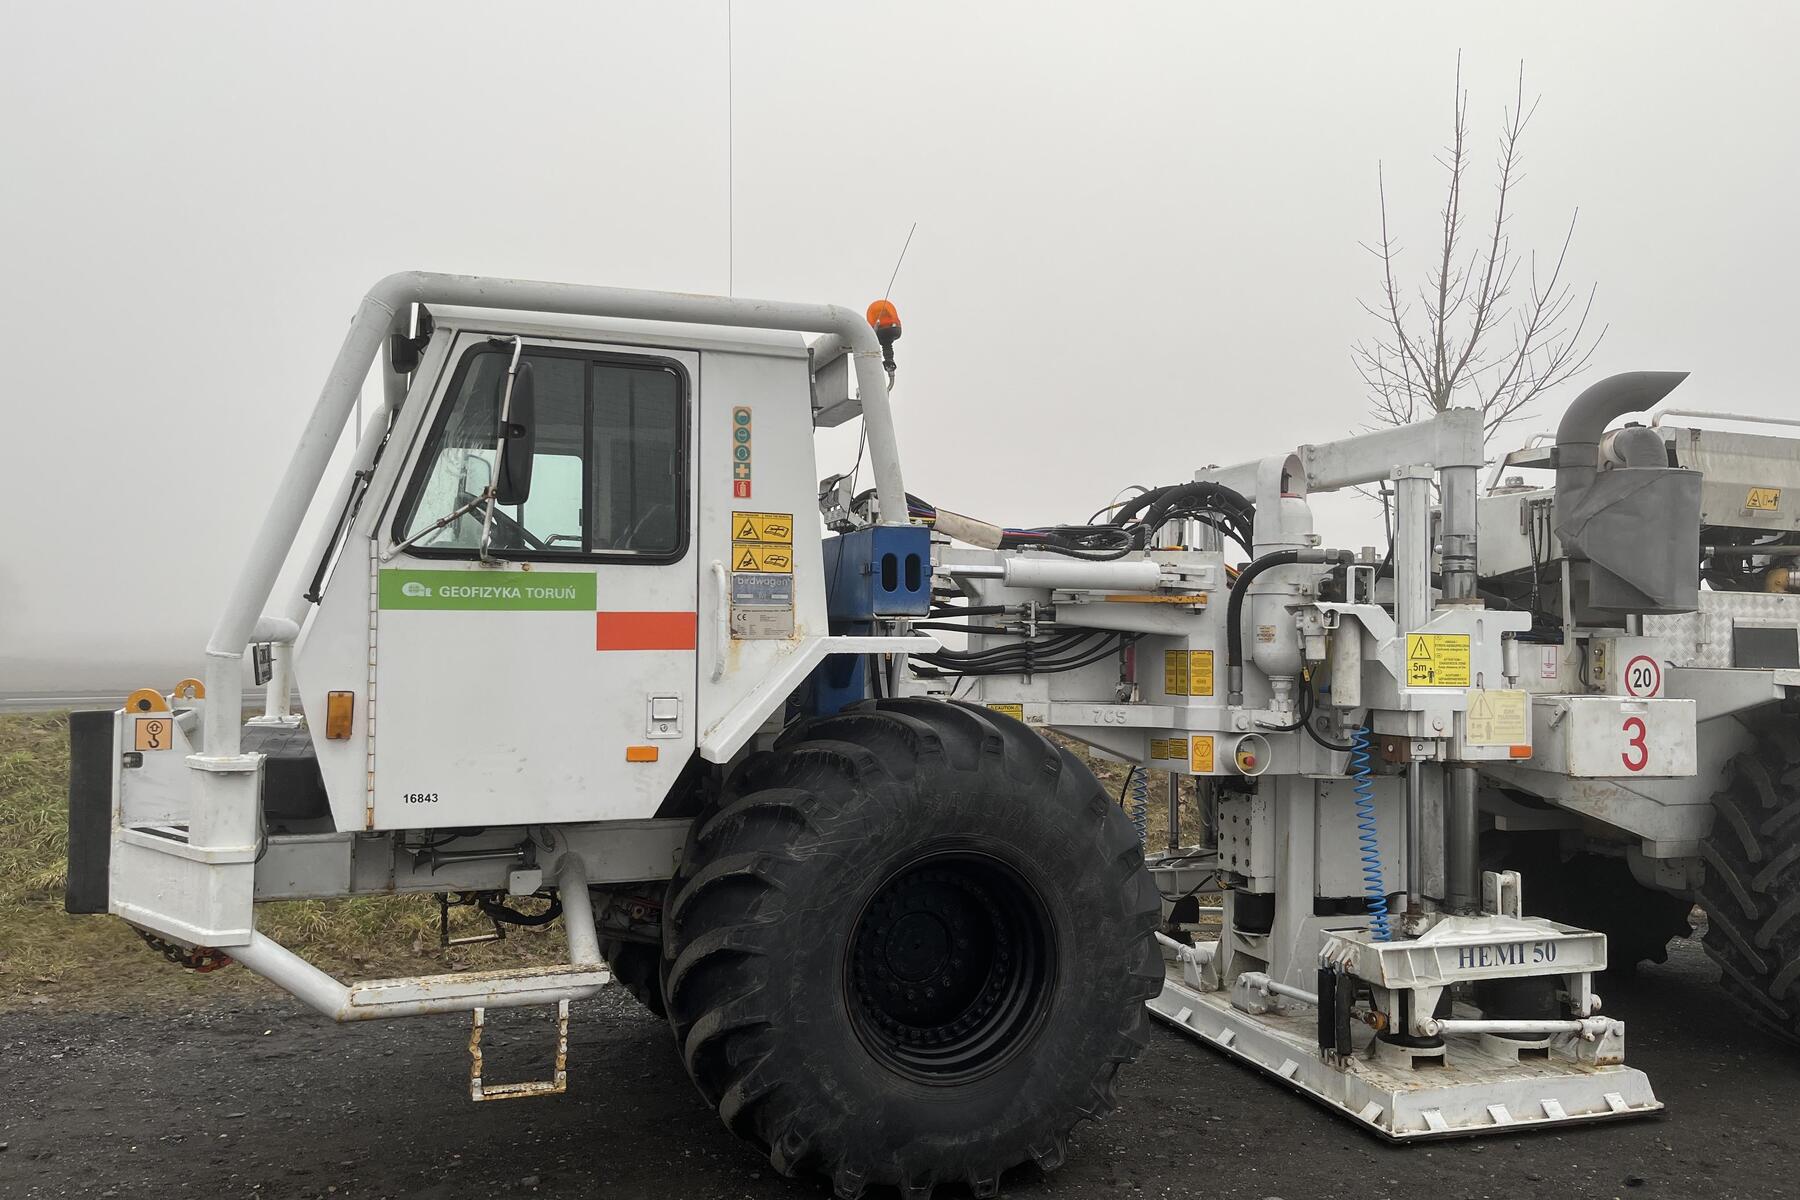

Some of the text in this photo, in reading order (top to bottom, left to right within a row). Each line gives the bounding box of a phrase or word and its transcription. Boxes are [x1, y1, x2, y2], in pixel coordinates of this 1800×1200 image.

[438, 585, 576, 599] GEOFIZYKA TORUŃ
[1412, 662, 1427, 672] 5m
[1633, 668, 1652, 688] 20
[1621, 716, 1649, 772] 3
[403, 793, 439, 804] 16843
[1458, 942, 1556, 969] HEMI 50
